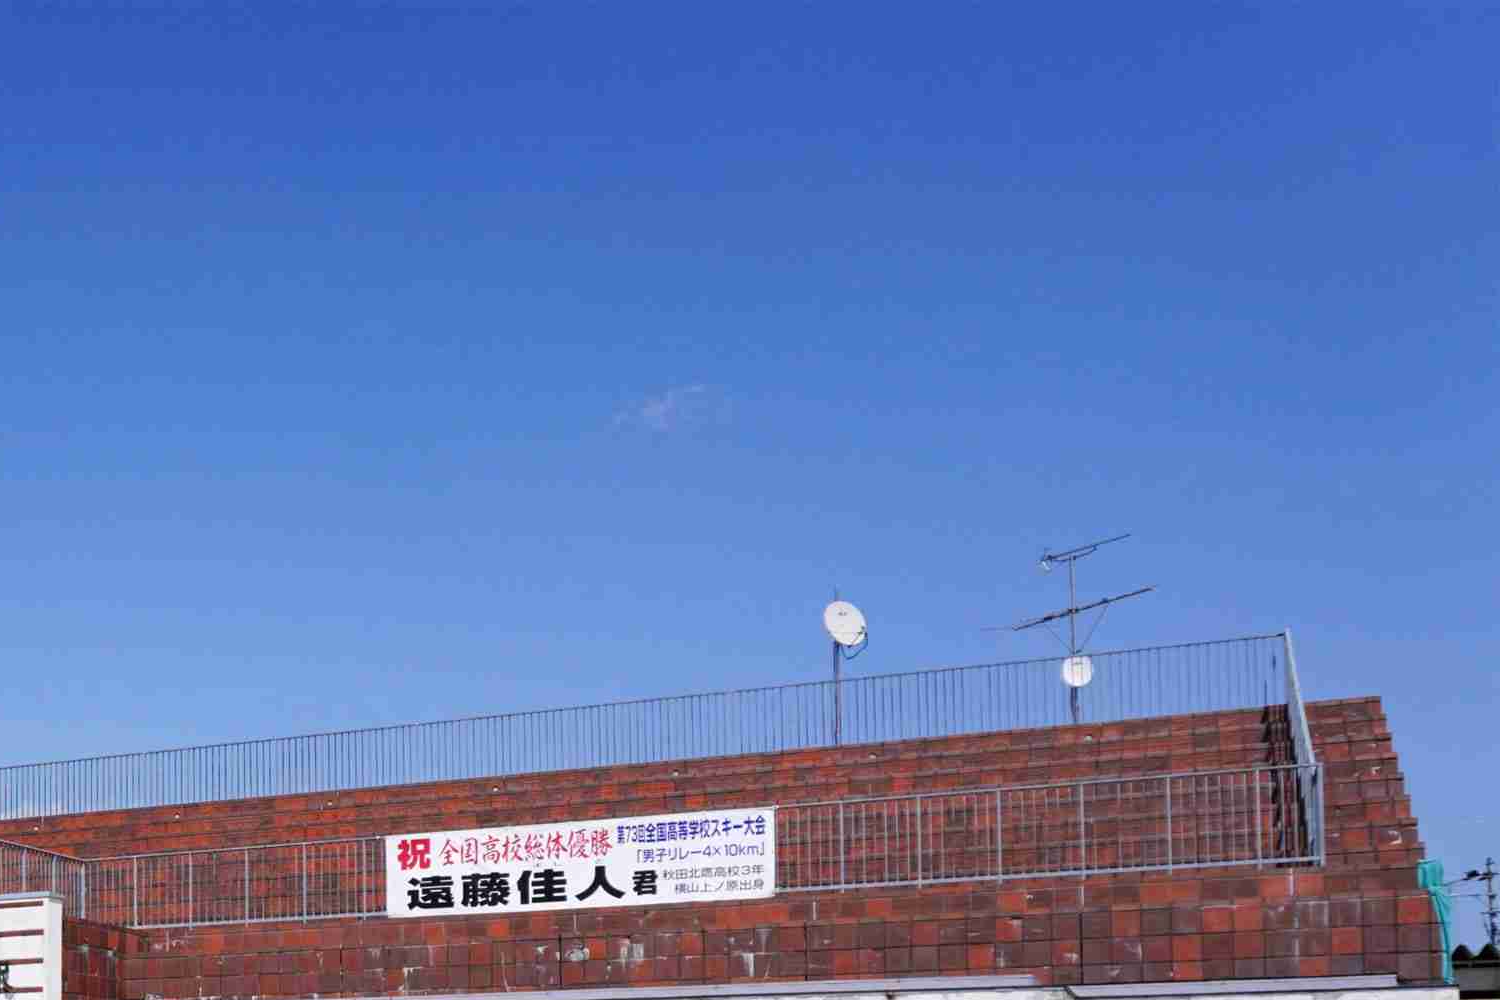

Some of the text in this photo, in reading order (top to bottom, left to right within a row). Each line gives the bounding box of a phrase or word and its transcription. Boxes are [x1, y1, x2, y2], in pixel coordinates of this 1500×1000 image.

[616, 815, 766, 844] 第73回全国高等学校スキー大会
[397, 828, 613, 870] 祝 全国高校総体優勝
